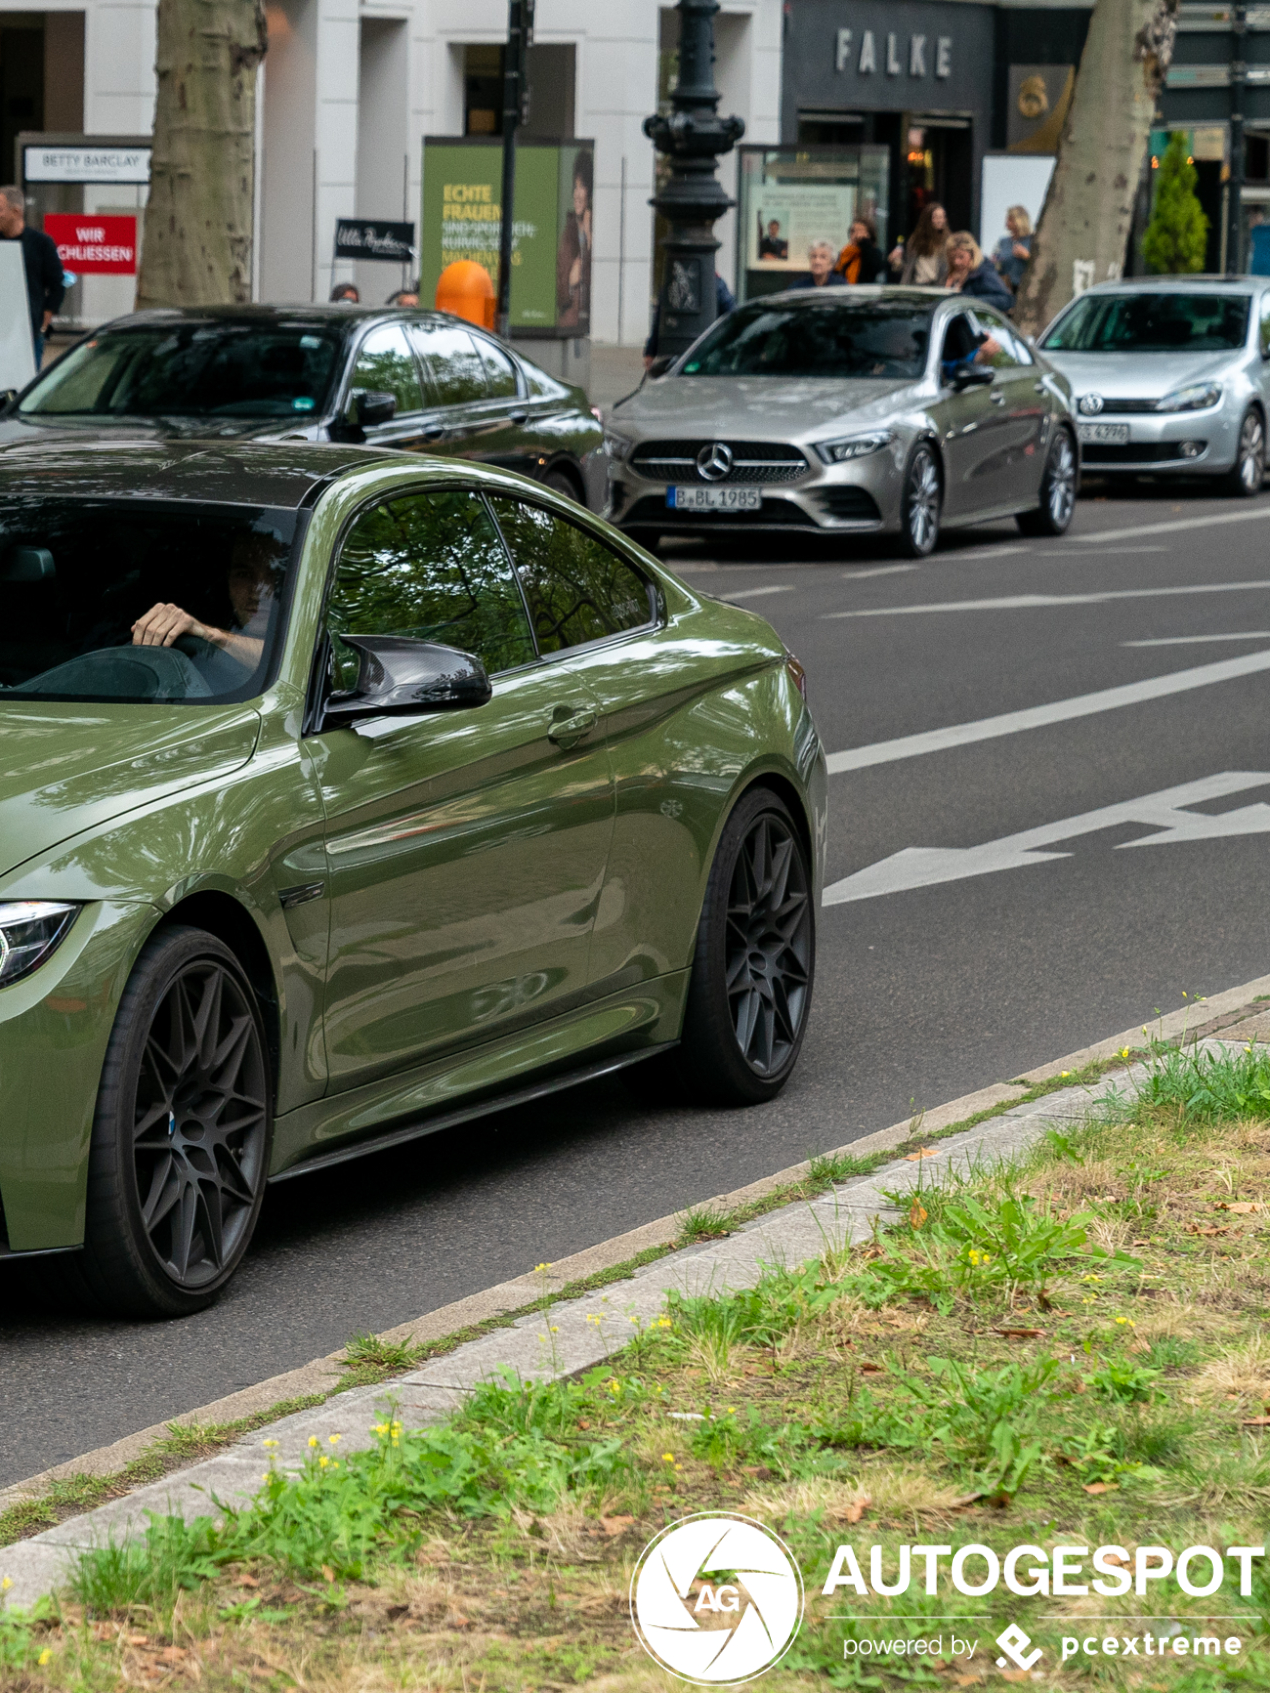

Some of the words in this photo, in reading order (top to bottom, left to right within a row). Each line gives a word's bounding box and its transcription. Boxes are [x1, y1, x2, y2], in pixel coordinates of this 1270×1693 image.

[836, 27, 952, 77] FALKE
[43, 155, 79, 166] BETTY
[84, 155, 140, 167] BARCLAY
[443, 184, 492, 202] ECHTE
[76, 227, 105, 242] WIR
[57, 244, 133, 261] CHLIESSEN
[677, 490, 686, 505] B
[696, 490, 715, 506] BL
[719, 490, 757, 506] 1985
